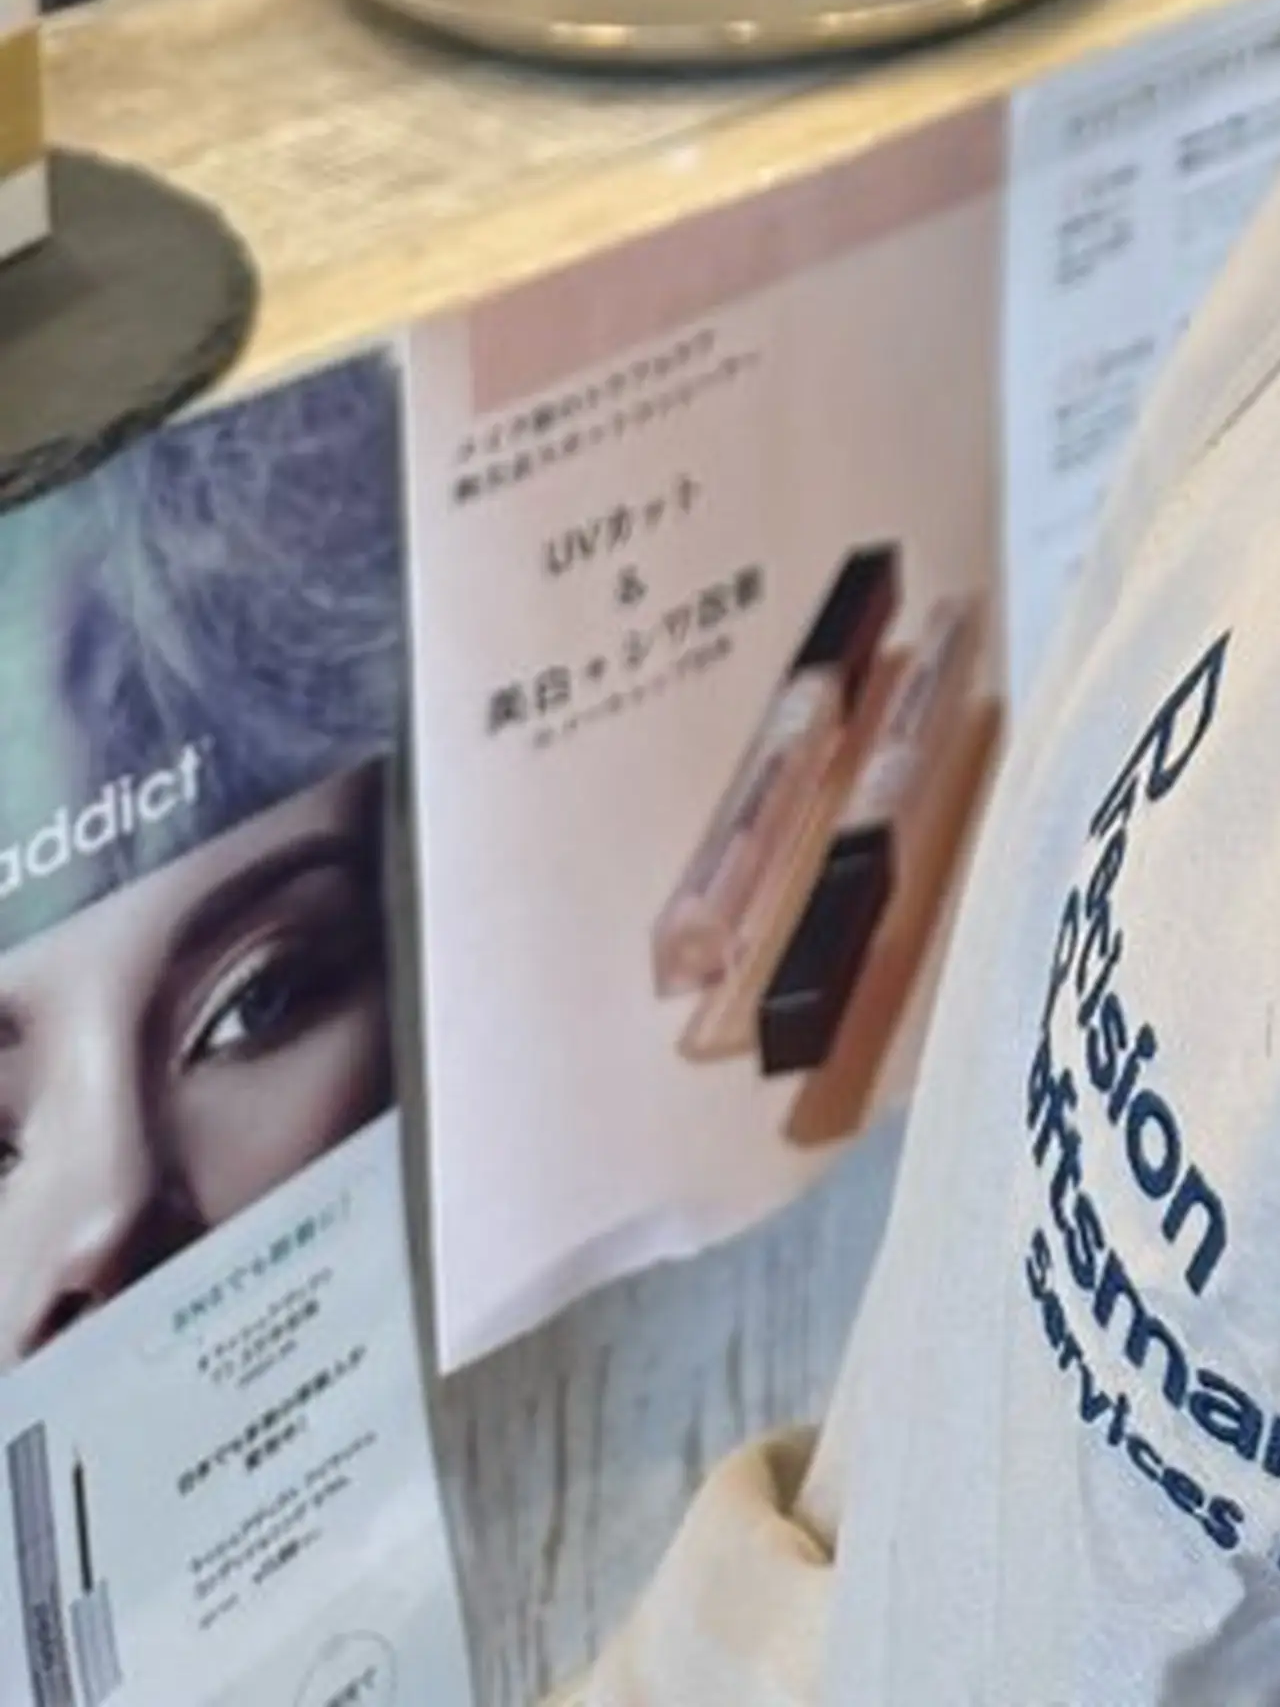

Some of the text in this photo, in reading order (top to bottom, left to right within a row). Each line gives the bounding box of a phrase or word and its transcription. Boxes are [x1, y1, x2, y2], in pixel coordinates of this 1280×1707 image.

[543, 471, 702, 576] UVカット
[1075, 627, 1232, 1297] Precision
